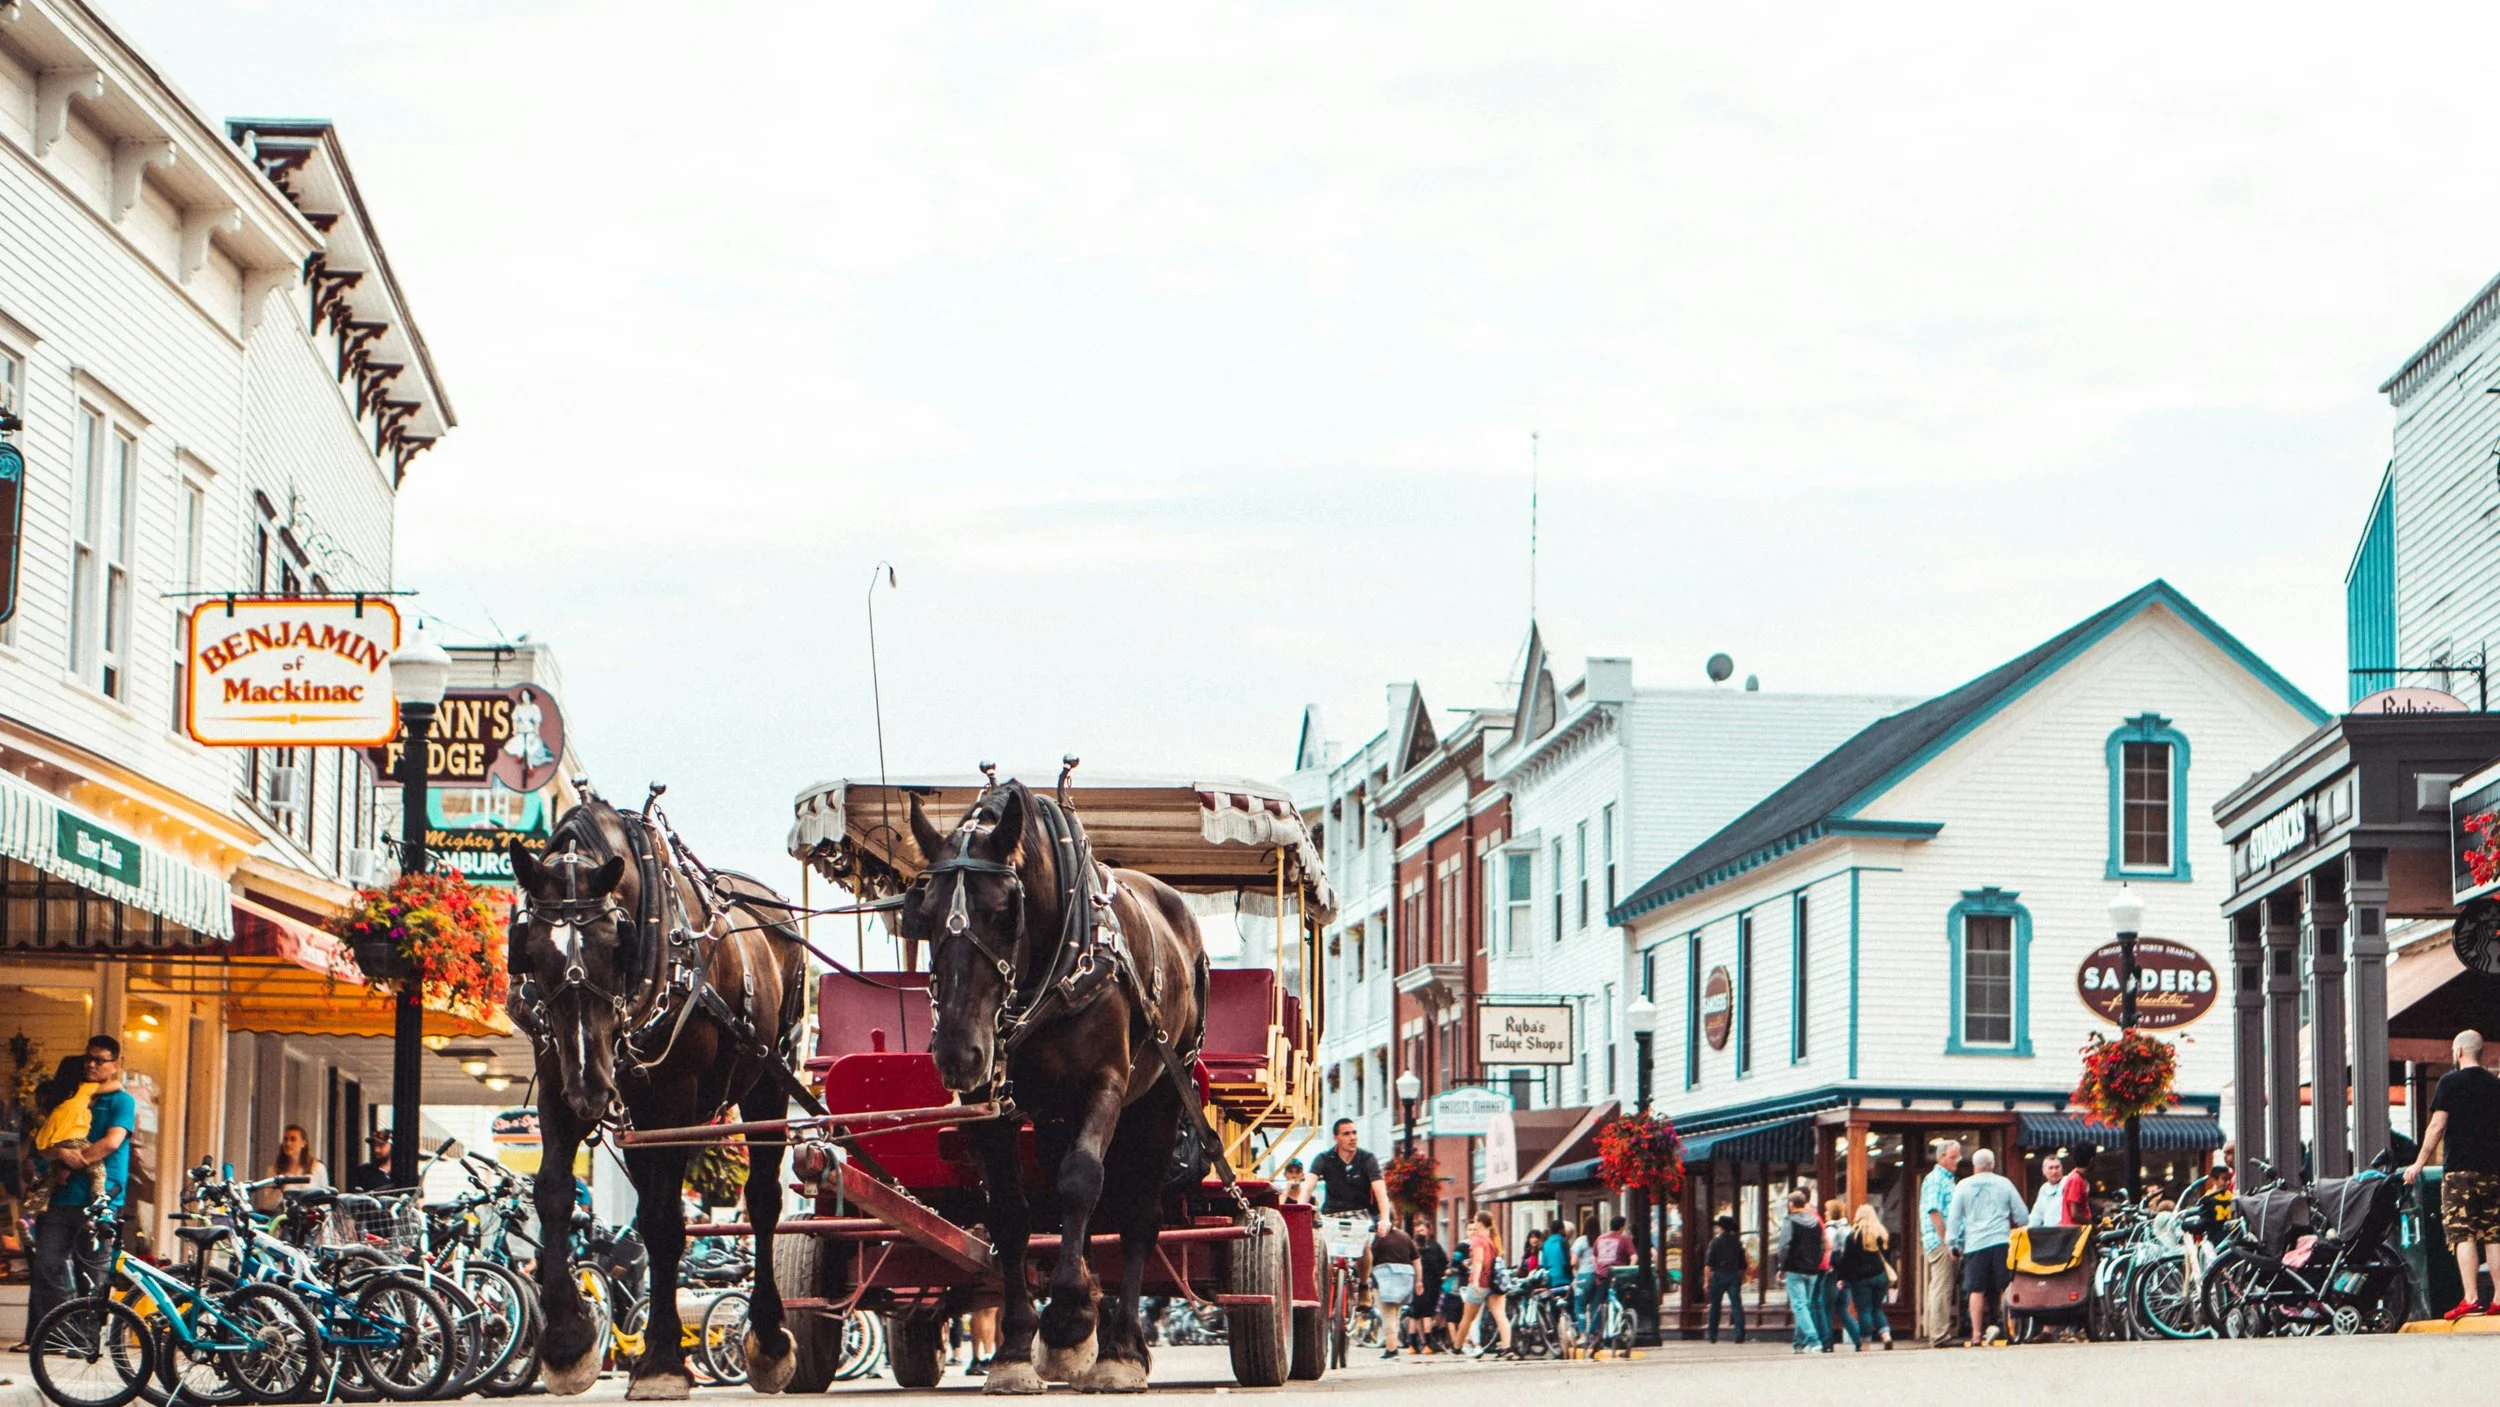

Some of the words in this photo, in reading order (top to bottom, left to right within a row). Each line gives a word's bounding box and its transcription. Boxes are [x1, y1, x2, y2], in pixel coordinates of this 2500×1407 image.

[199, 621, 389, 674] BENJAMIN
[282, 655, 304, 671] of
[223, 678, 364, 704] Mackinac
[400, 700, 510, 740] NN'S
[386, 742, 485, 776] FDGE
[425, 830, 495, 851] Mighty
[2249, 798, 2305, 871] STARBUCKS
[2084, 966, 2212, 993] SADERS
[1505, 1015, 1546, 1037] Ryba's
[1488, 1034, 1522, 1053] Fudge
[1526, 1036, 1563, 1053] Shops
